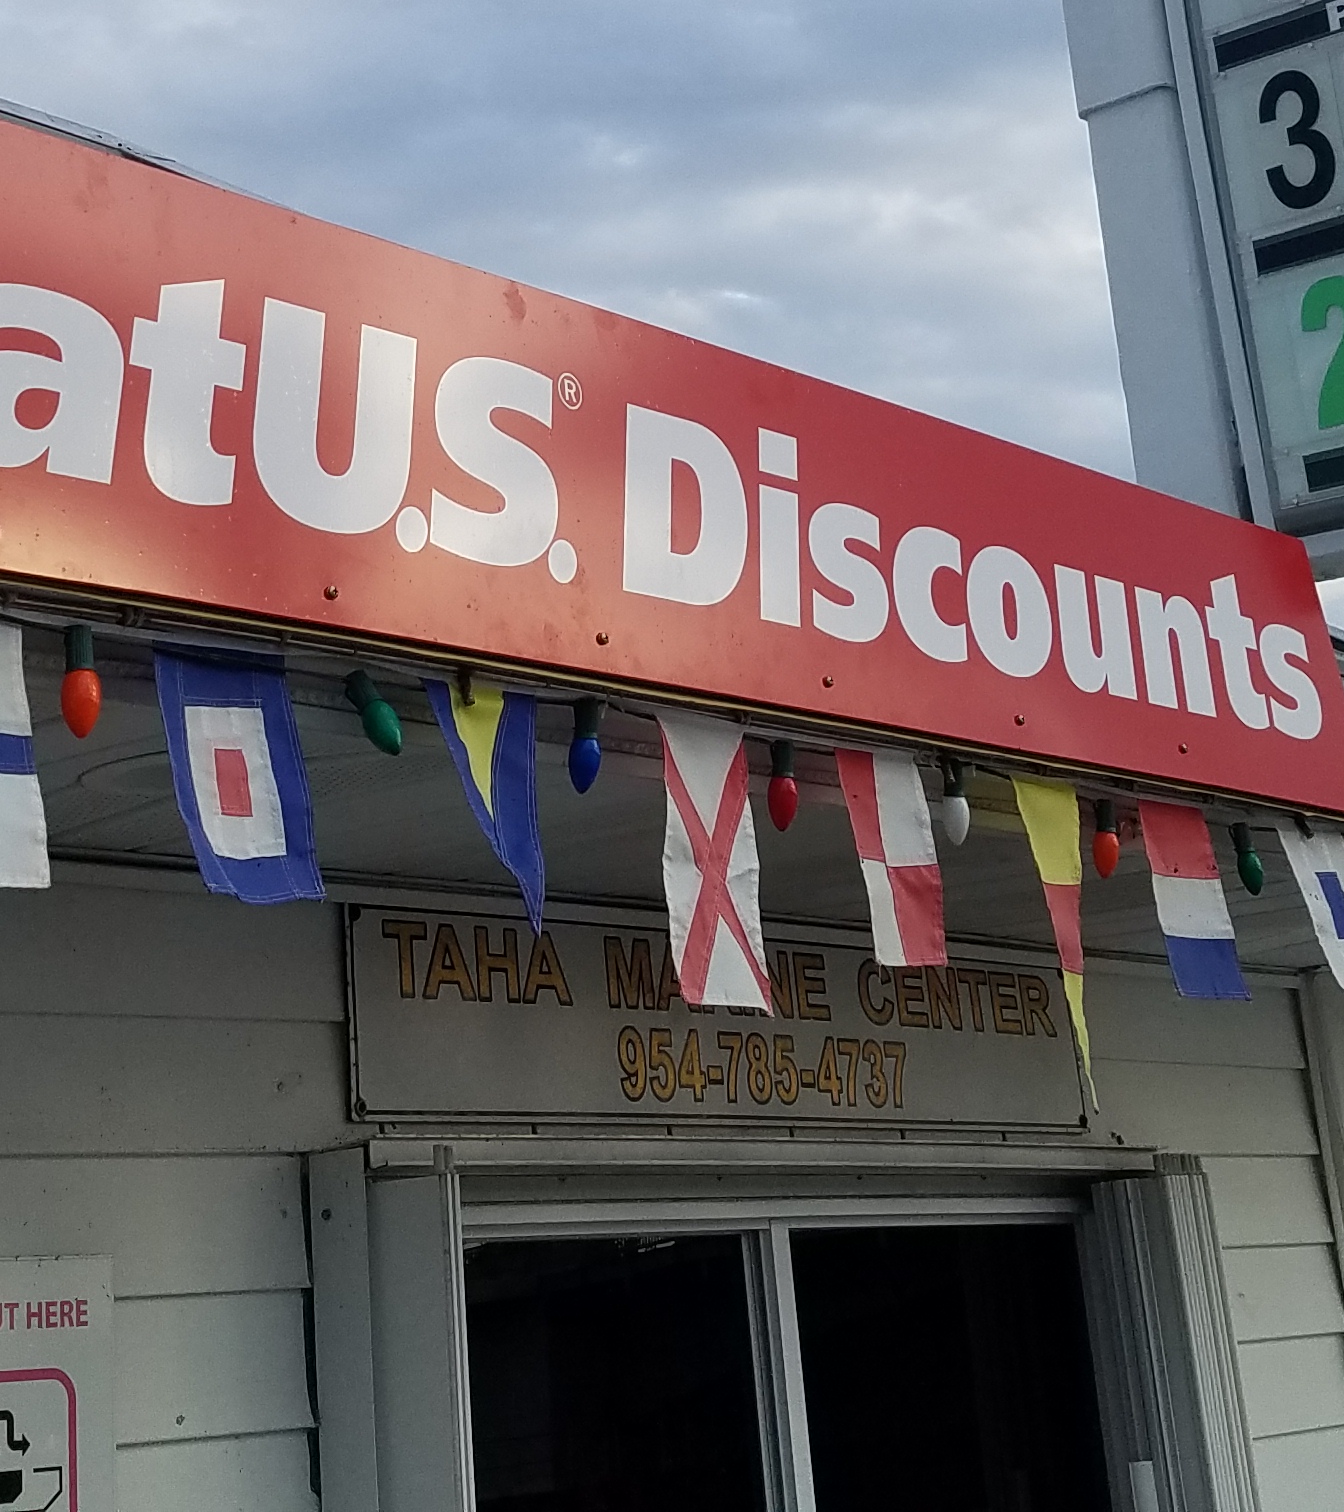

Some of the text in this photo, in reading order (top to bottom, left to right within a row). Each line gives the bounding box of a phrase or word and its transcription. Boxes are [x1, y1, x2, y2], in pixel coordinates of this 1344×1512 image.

[622, 402, 1324, 741] Discounts
[382, 919, 1058, 1037] TAHA MANE CENTER
[617, 1025, 907, 1109] 954-785-4737
[26, 1298, 90, 1330] HERE
